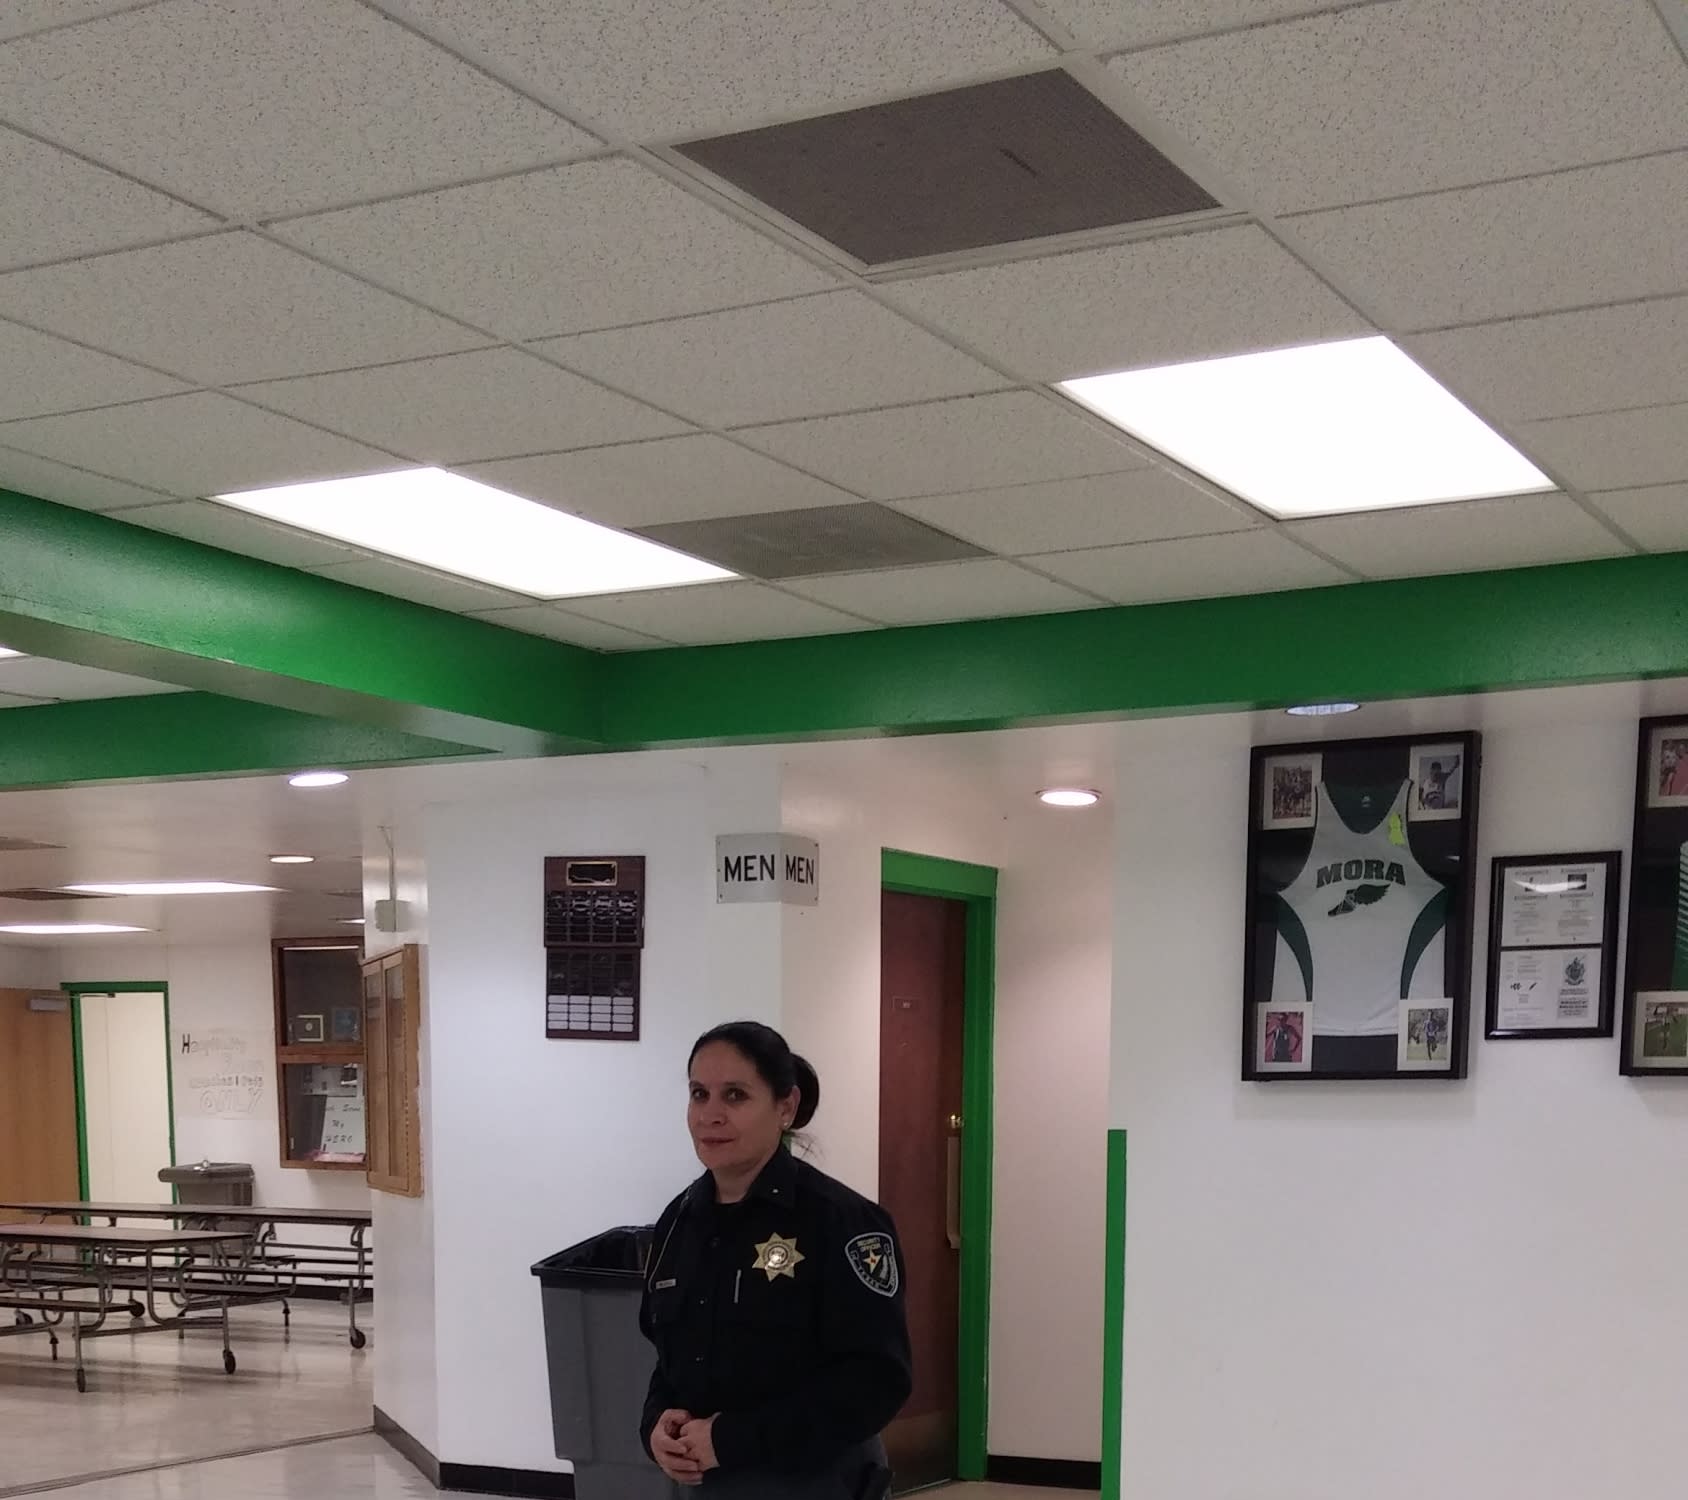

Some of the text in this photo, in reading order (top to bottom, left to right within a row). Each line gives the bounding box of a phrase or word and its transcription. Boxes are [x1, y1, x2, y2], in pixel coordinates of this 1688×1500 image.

[724, 854, 815, 885] MEN MEN
[1316, 859, 1406, 888] MORA
